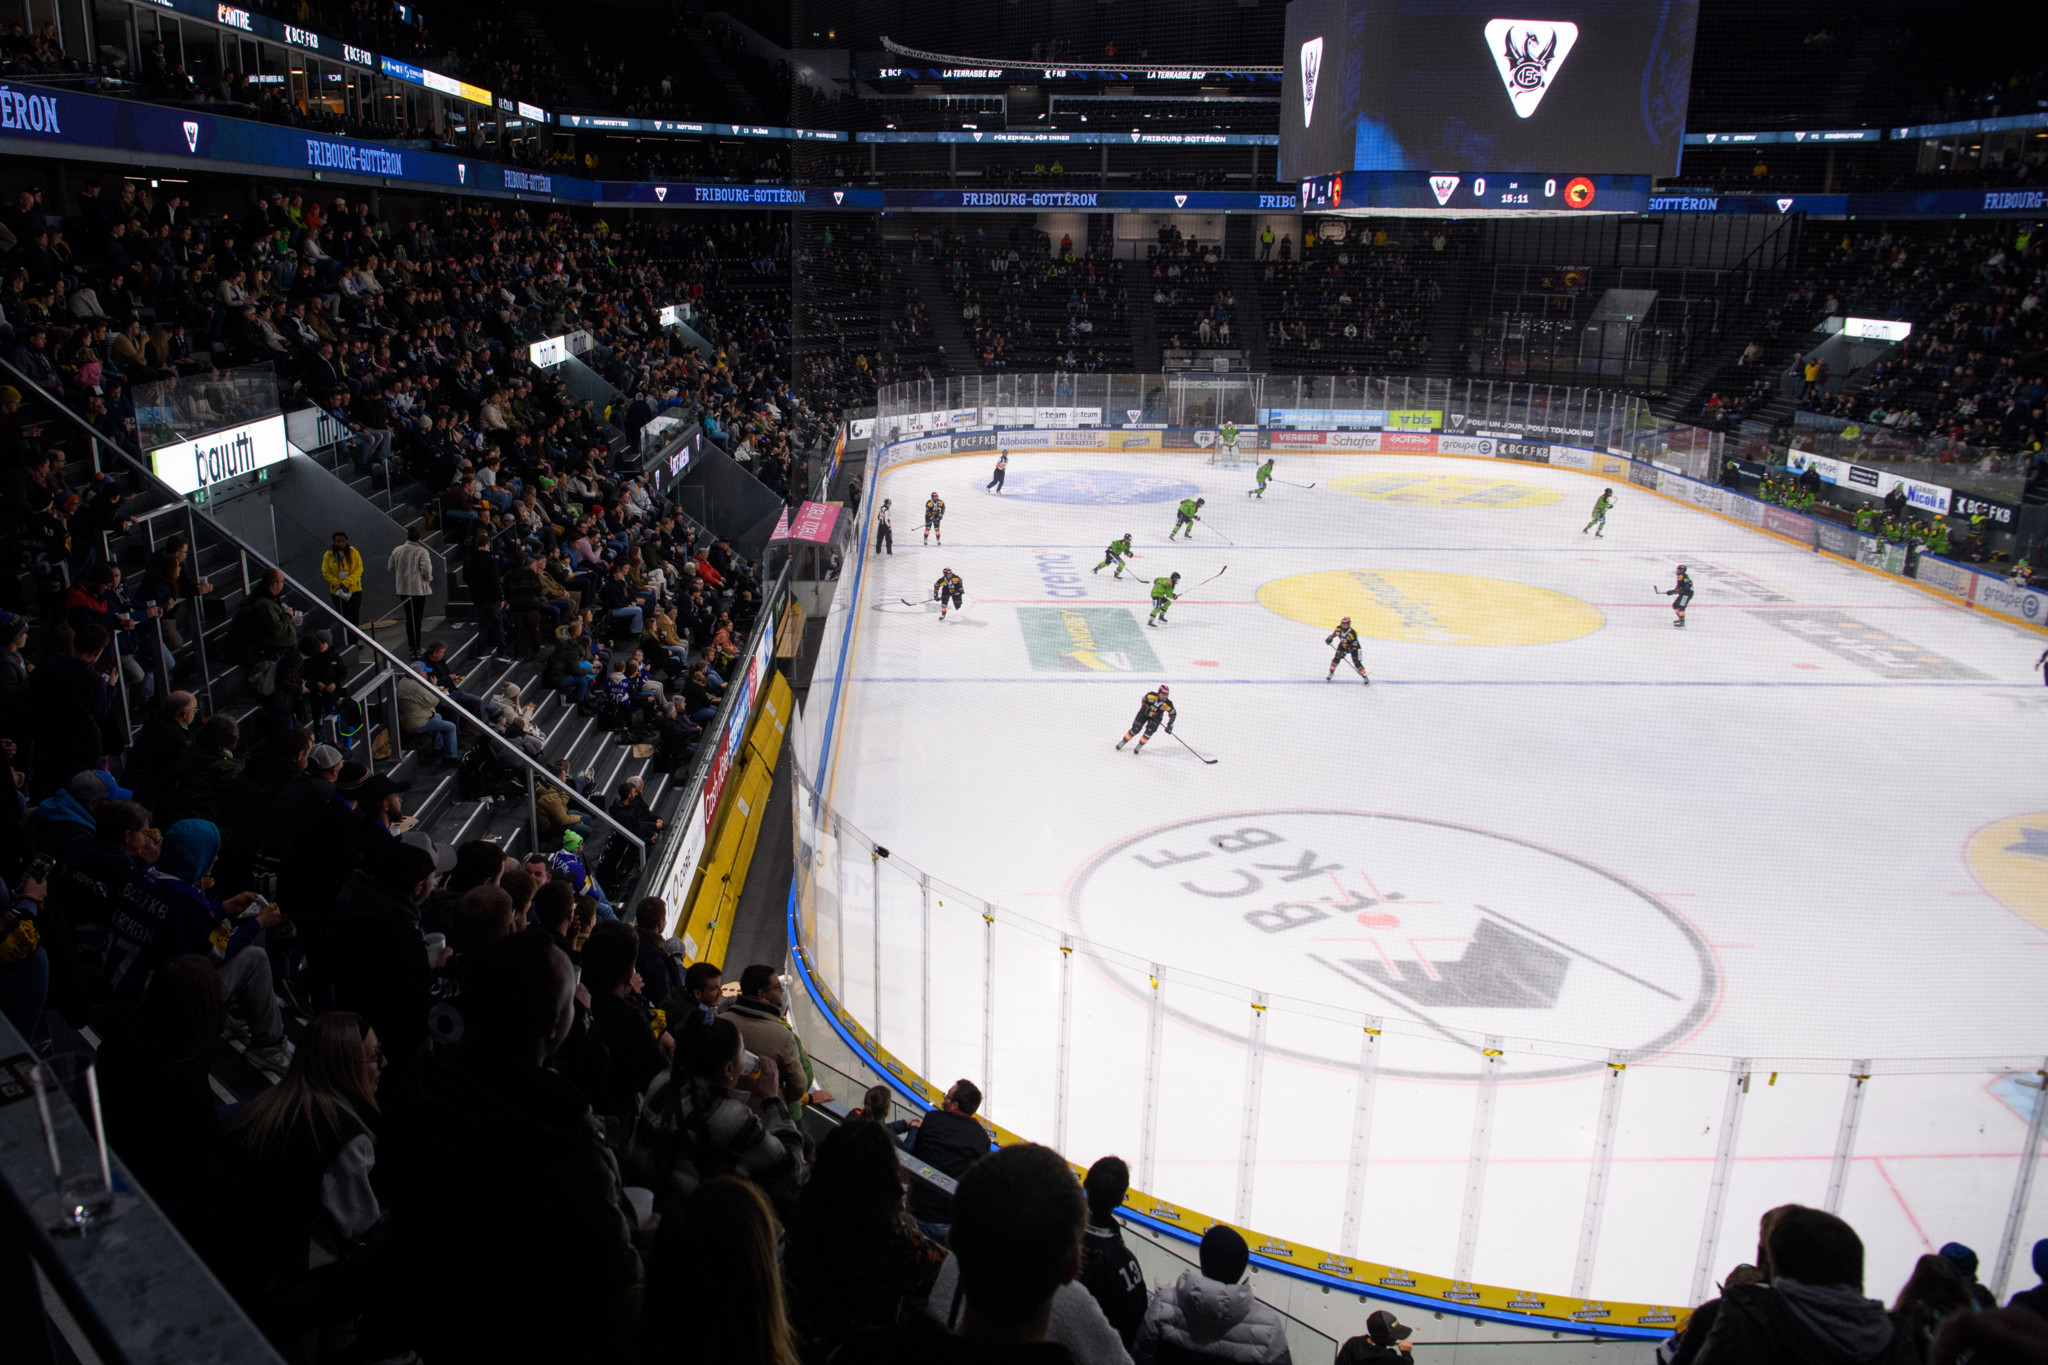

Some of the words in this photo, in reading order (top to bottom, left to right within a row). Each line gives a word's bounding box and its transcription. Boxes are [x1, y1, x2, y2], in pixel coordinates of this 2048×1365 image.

[983, 70, 1002, 78] BCF
[1147, 71, 1159, 79] LA
[1159, 71, 1186, 79] TERRASSE
[306, 139, 403, 176] FRIBOURG-GOTTÉRON
[504, 169, 551, 192] FRIBOURG-GOTTÉRON
[1474, 179, 1485, 196] 0
[1545, 179, 1556, 197] 0
[695, 187, 806, 203] FRIBOURG-GOTTÉRON
[962, 192, 1097, 206] FRIBOURG-GOTTÉRON
[1501, 194, 1529, 204] 15:11
[1279, 434, 1319, 442] VERBIER
[1331, 434, 1377, 448] Schafer
[915, 441, 948, 451] MORAND
[1442, 440, 1477, 450] groupe
[1983, 586, 2022, 609] groupe
[1259, 1246, 1292, 1256] CARDINAL
[1318, 1263, 1352, 1273] CARDINAL
[1119, 1260, 1143, 1292] 13
[1380, 1278, 1416, 1286] CARDINAL
[1443, 1291, 1480, 1299] CARDINAL
[1508, 1301, 1544, 1309] CARDINAL
[1574, 1310, 1610, 1318] CARDINAL
[1638, 1315, 1676, 1323] CARDINAL
